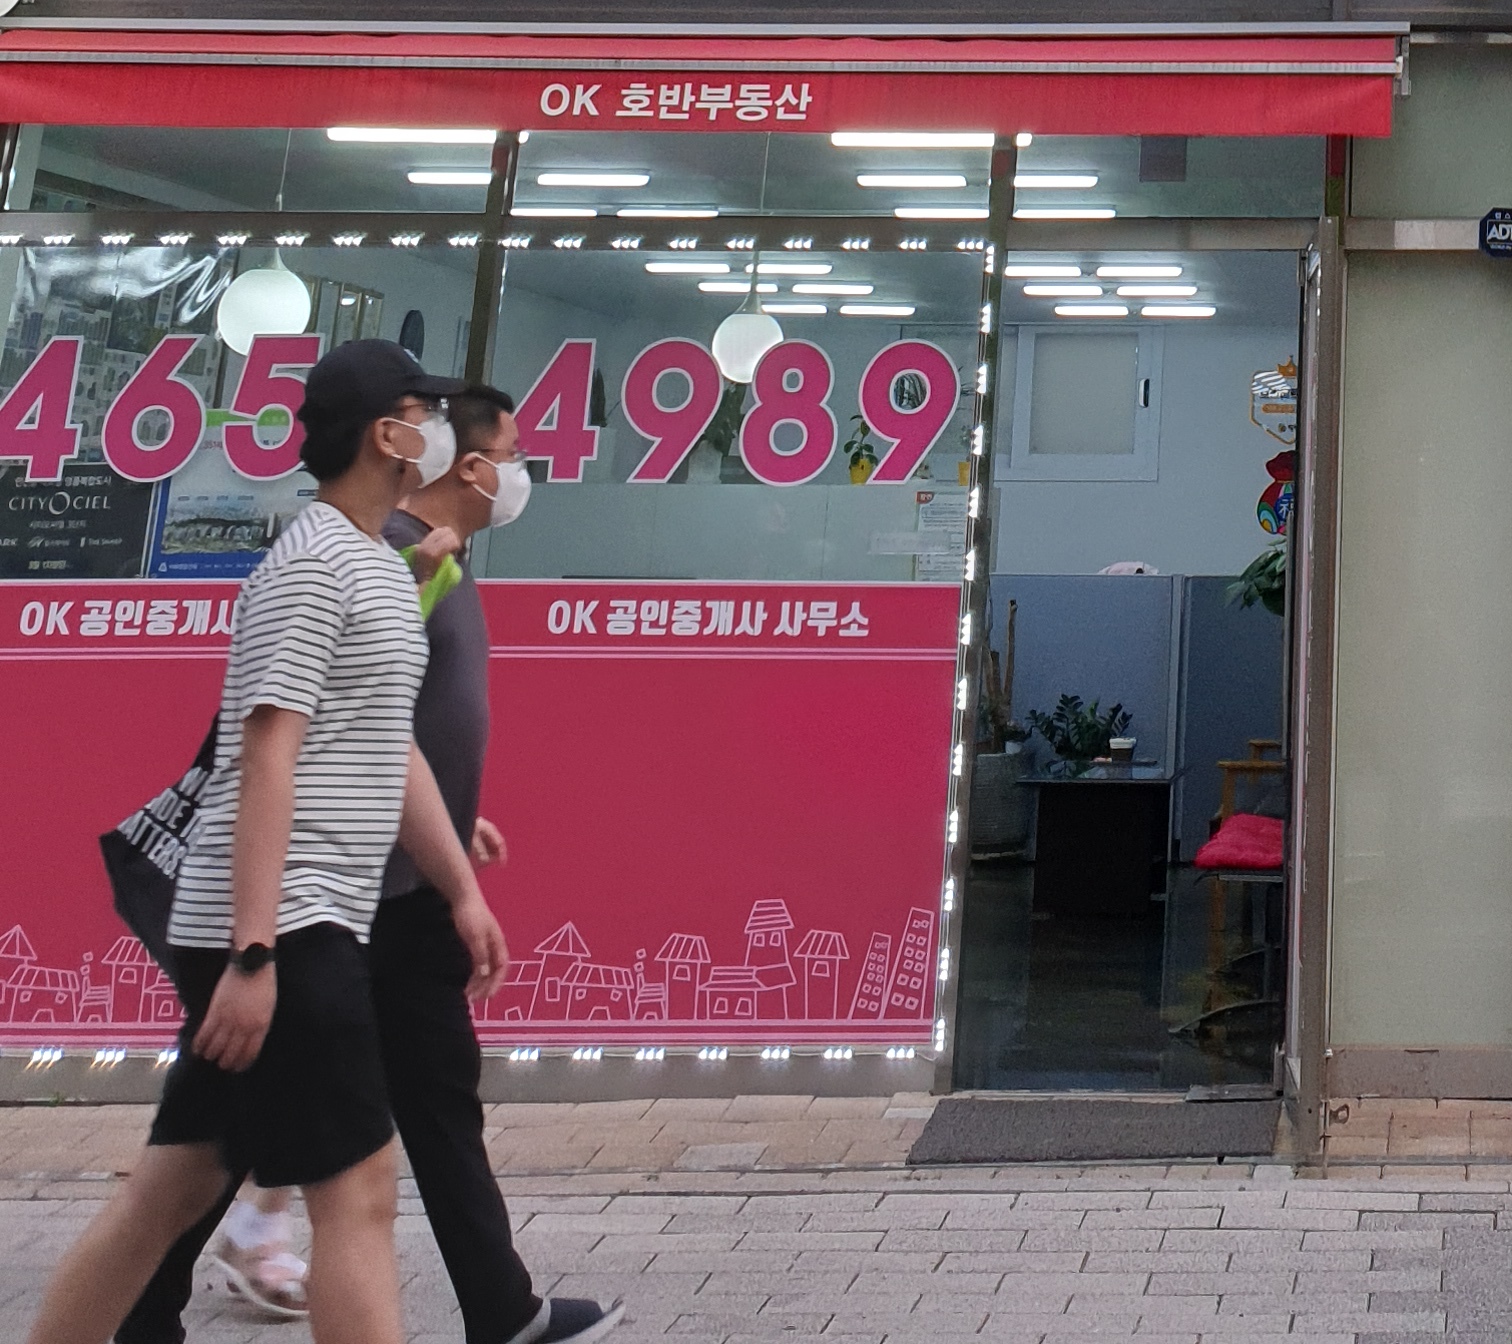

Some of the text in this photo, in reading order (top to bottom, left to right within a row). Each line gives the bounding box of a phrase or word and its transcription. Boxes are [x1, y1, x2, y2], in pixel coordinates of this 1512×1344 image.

[540, 81, 813, 121] OK 호반부동산
[513, 336, 962, 486] 4989
[20, 600, 75, 636] OK
[548, 599, 871, 637] OK 공인중개사 사무소
